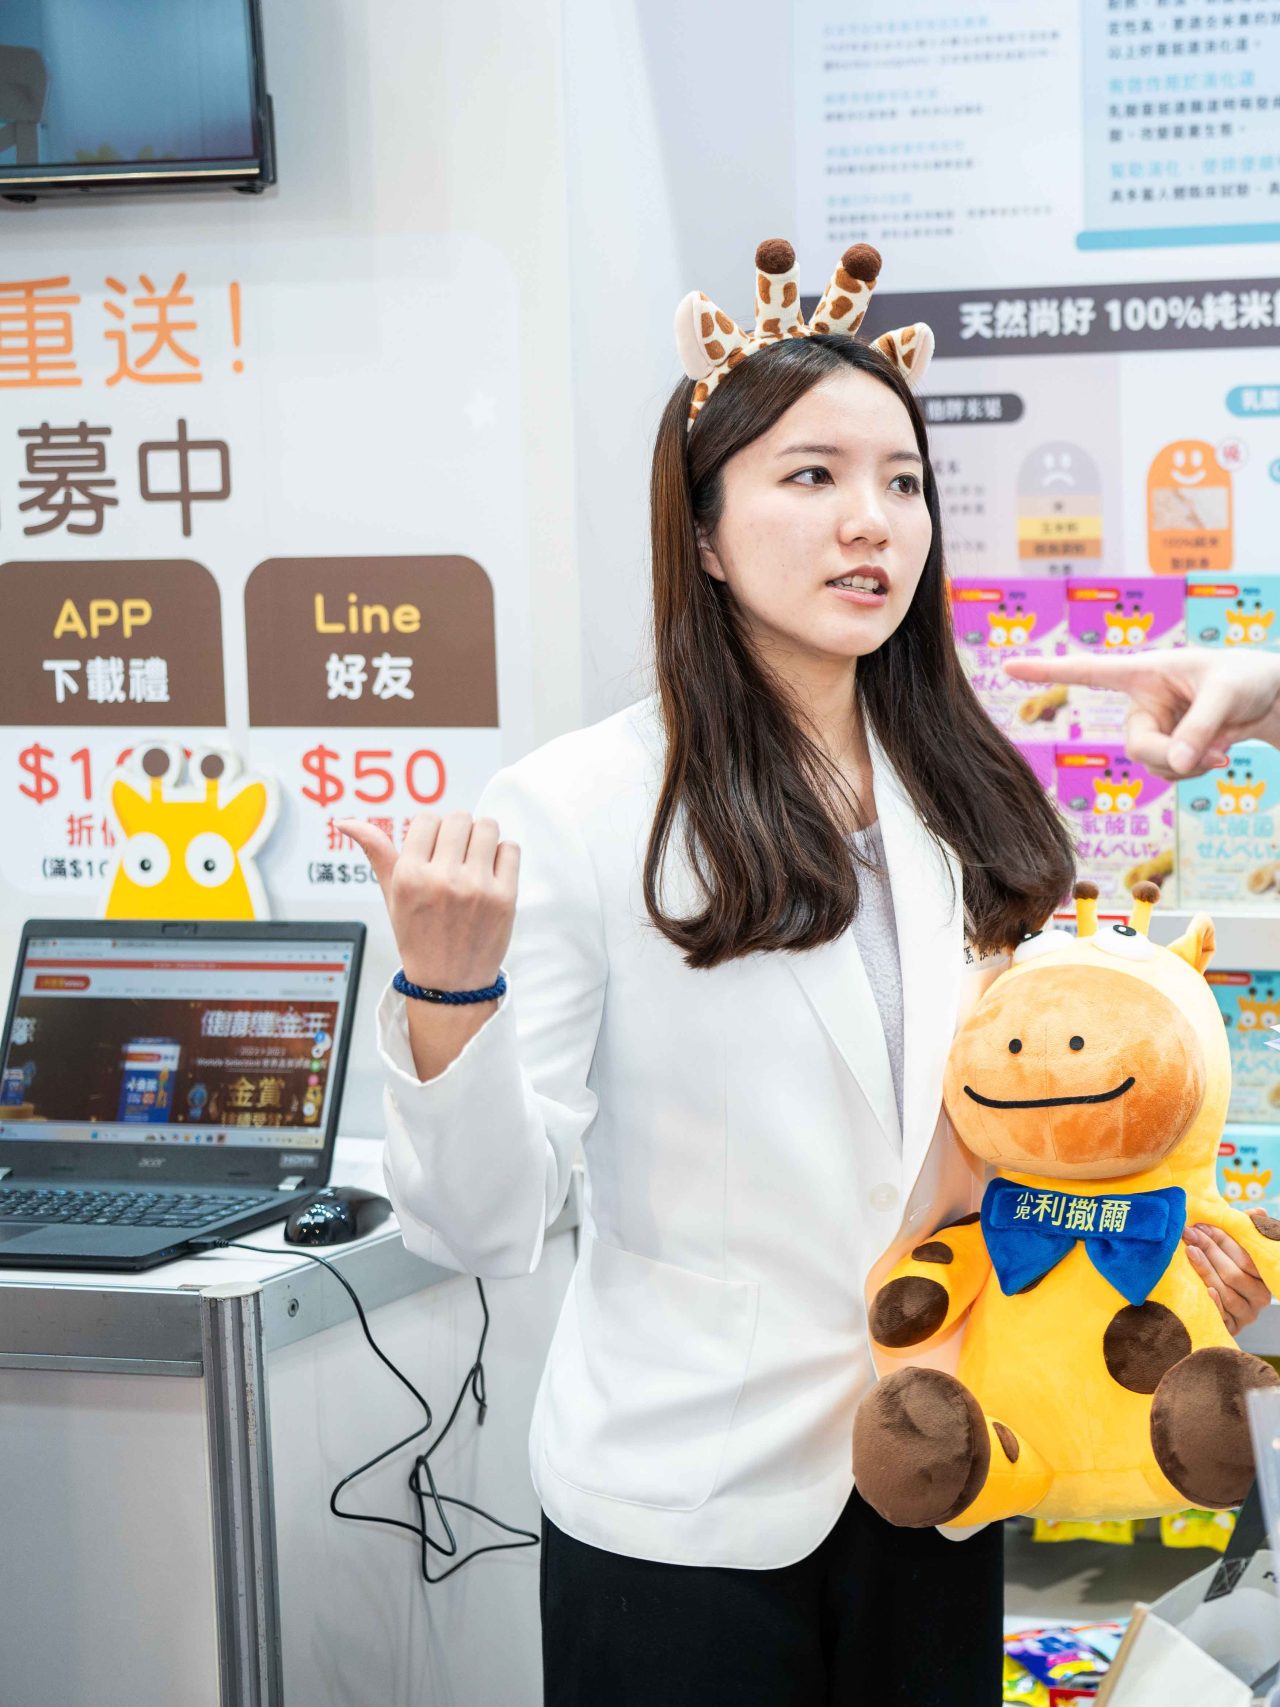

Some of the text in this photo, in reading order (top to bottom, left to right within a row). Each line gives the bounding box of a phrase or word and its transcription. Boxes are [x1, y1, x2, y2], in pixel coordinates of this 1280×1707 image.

[960, 298, 1095, 340] 天然尚好
[53, 598, 153, 639] APP
[313, 592, 422, 635] Line
[43, 656, 170, 704] 下載禮
[325, 652, 415, 701] 好友
[301, 744, 446, 807] $50
